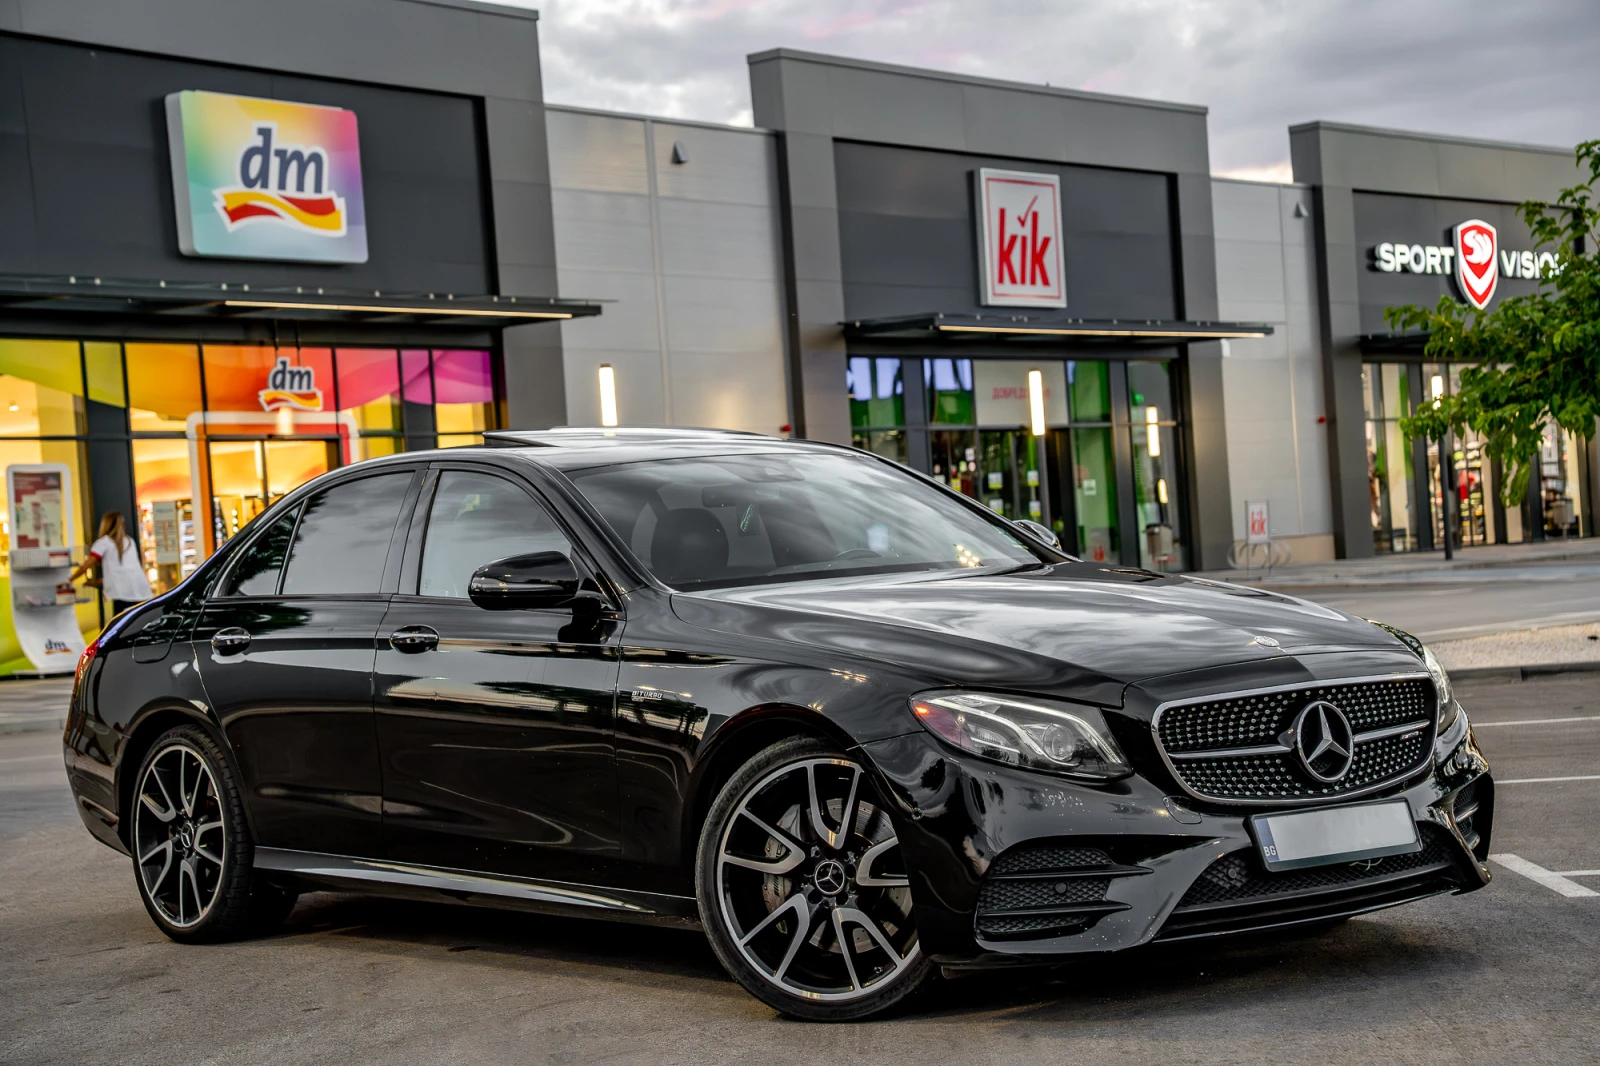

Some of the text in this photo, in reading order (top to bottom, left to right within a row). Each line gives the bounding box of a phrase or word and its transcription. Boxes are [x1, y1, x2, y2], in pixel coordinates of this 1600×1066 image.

[240, 127, 324, 194] dm
[997, 196, 1052, 287] kik
[1377, 242, 1454, 275] SPORT
[271, 360, 313, 391] dm
[45, 638, 67, 650] dm
[1263, 845, 1277, 857] BG
